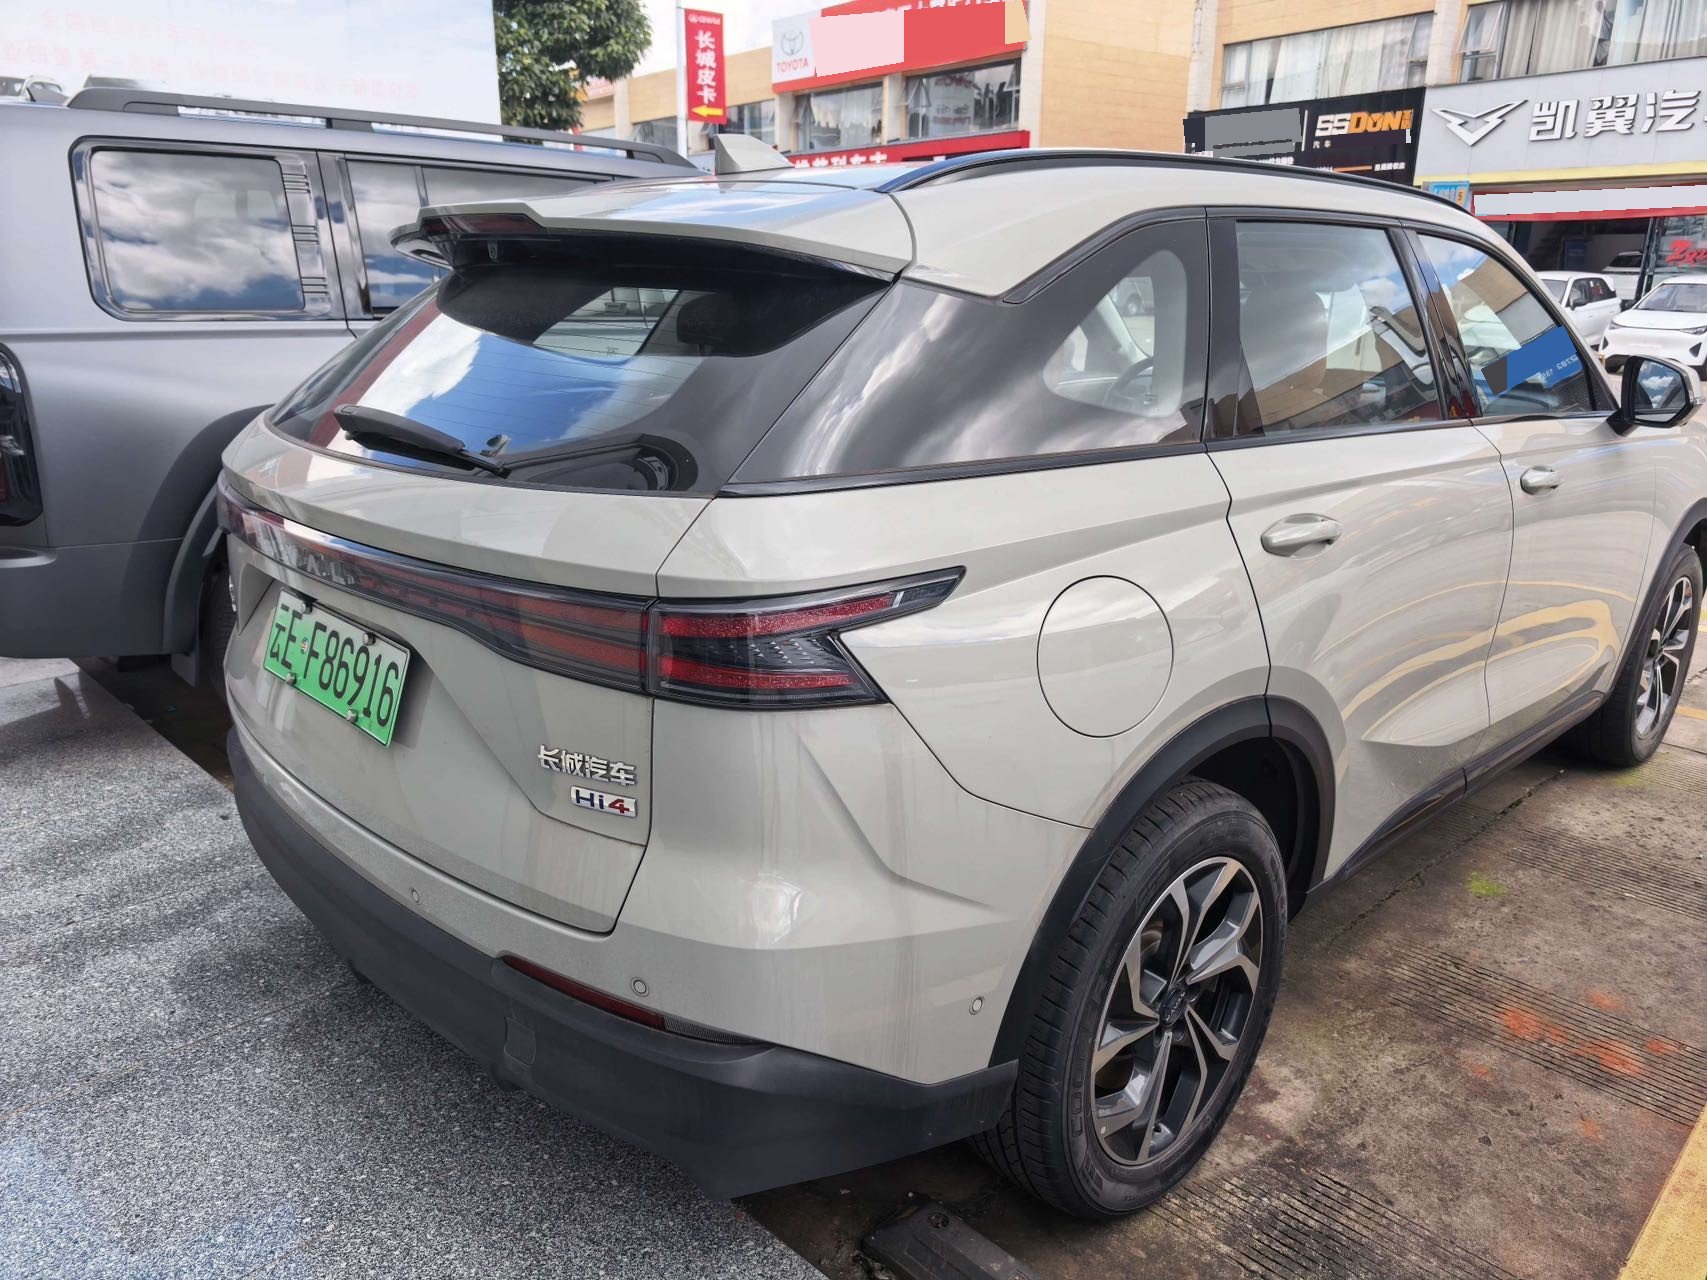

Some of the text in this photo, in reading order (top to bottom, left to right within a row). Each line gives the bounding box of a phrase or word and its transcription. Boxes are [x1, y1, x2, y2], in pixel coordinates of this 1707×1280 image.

[694, 30, 717, 104] 长城皮卡
[776, 57, 809, 73] TOYOTA
[1529, 89, 1707, 142] 凯翼汽
[537, 744, 637, 787] 长城汽车
[575, 789, 630, 815] Hi4
